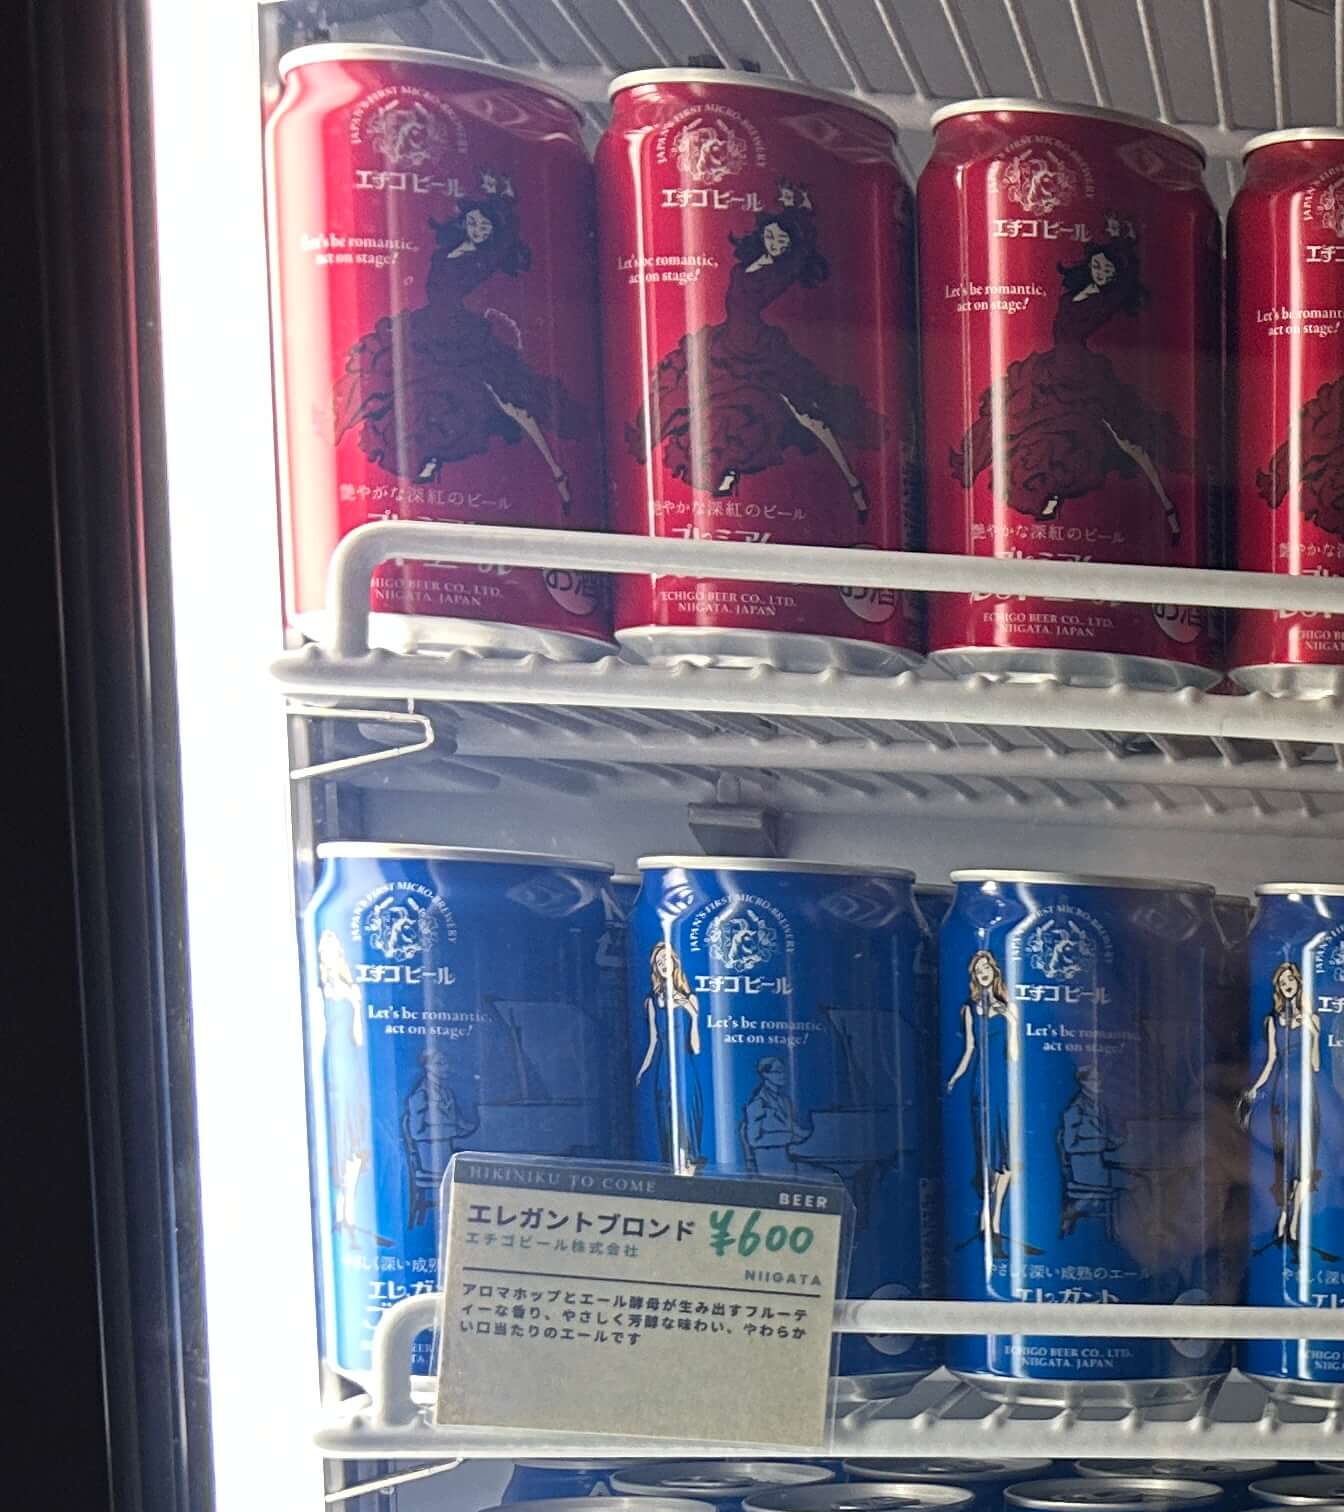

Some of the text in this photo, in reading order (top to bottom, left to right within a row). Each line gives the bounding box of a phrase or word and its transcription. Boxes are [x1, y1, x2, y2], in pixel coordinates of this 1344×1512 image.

[970, 284, 983, 296] be
[985, 285, 1048, 298] romantic,
[957, 299, 1029, 315] act on stage!
[1257, 309, 1279, 323] Let's
[1267, 325, 1283, 337] act
[1303, 322, 1340, 339] stage!
[367, 1004, 399, 1020] Let's
[384, 1021, 404, 1035] act
[408, 1024, 427, 1035] on
[707, 1014, 738, 1030] Let's
[723, 1031, 743, 1044] act
[746, 1033, 764, 1044] on
[568, 1172, 596, 1191] TO
[601, 1174, 657, 1194] COME
[779, 1192, 828, 1208] BEER
[467, 1203, 696, 1242] エレガントブロンド
[709, 1208, 814, 1257] ¥600
[465, 1231, 640, 1259] エチゴビール株式会社
[744, 1269, 823, 1287] NIIGATA
[460, 1320, 642, 1346] い口当たりのエールです
